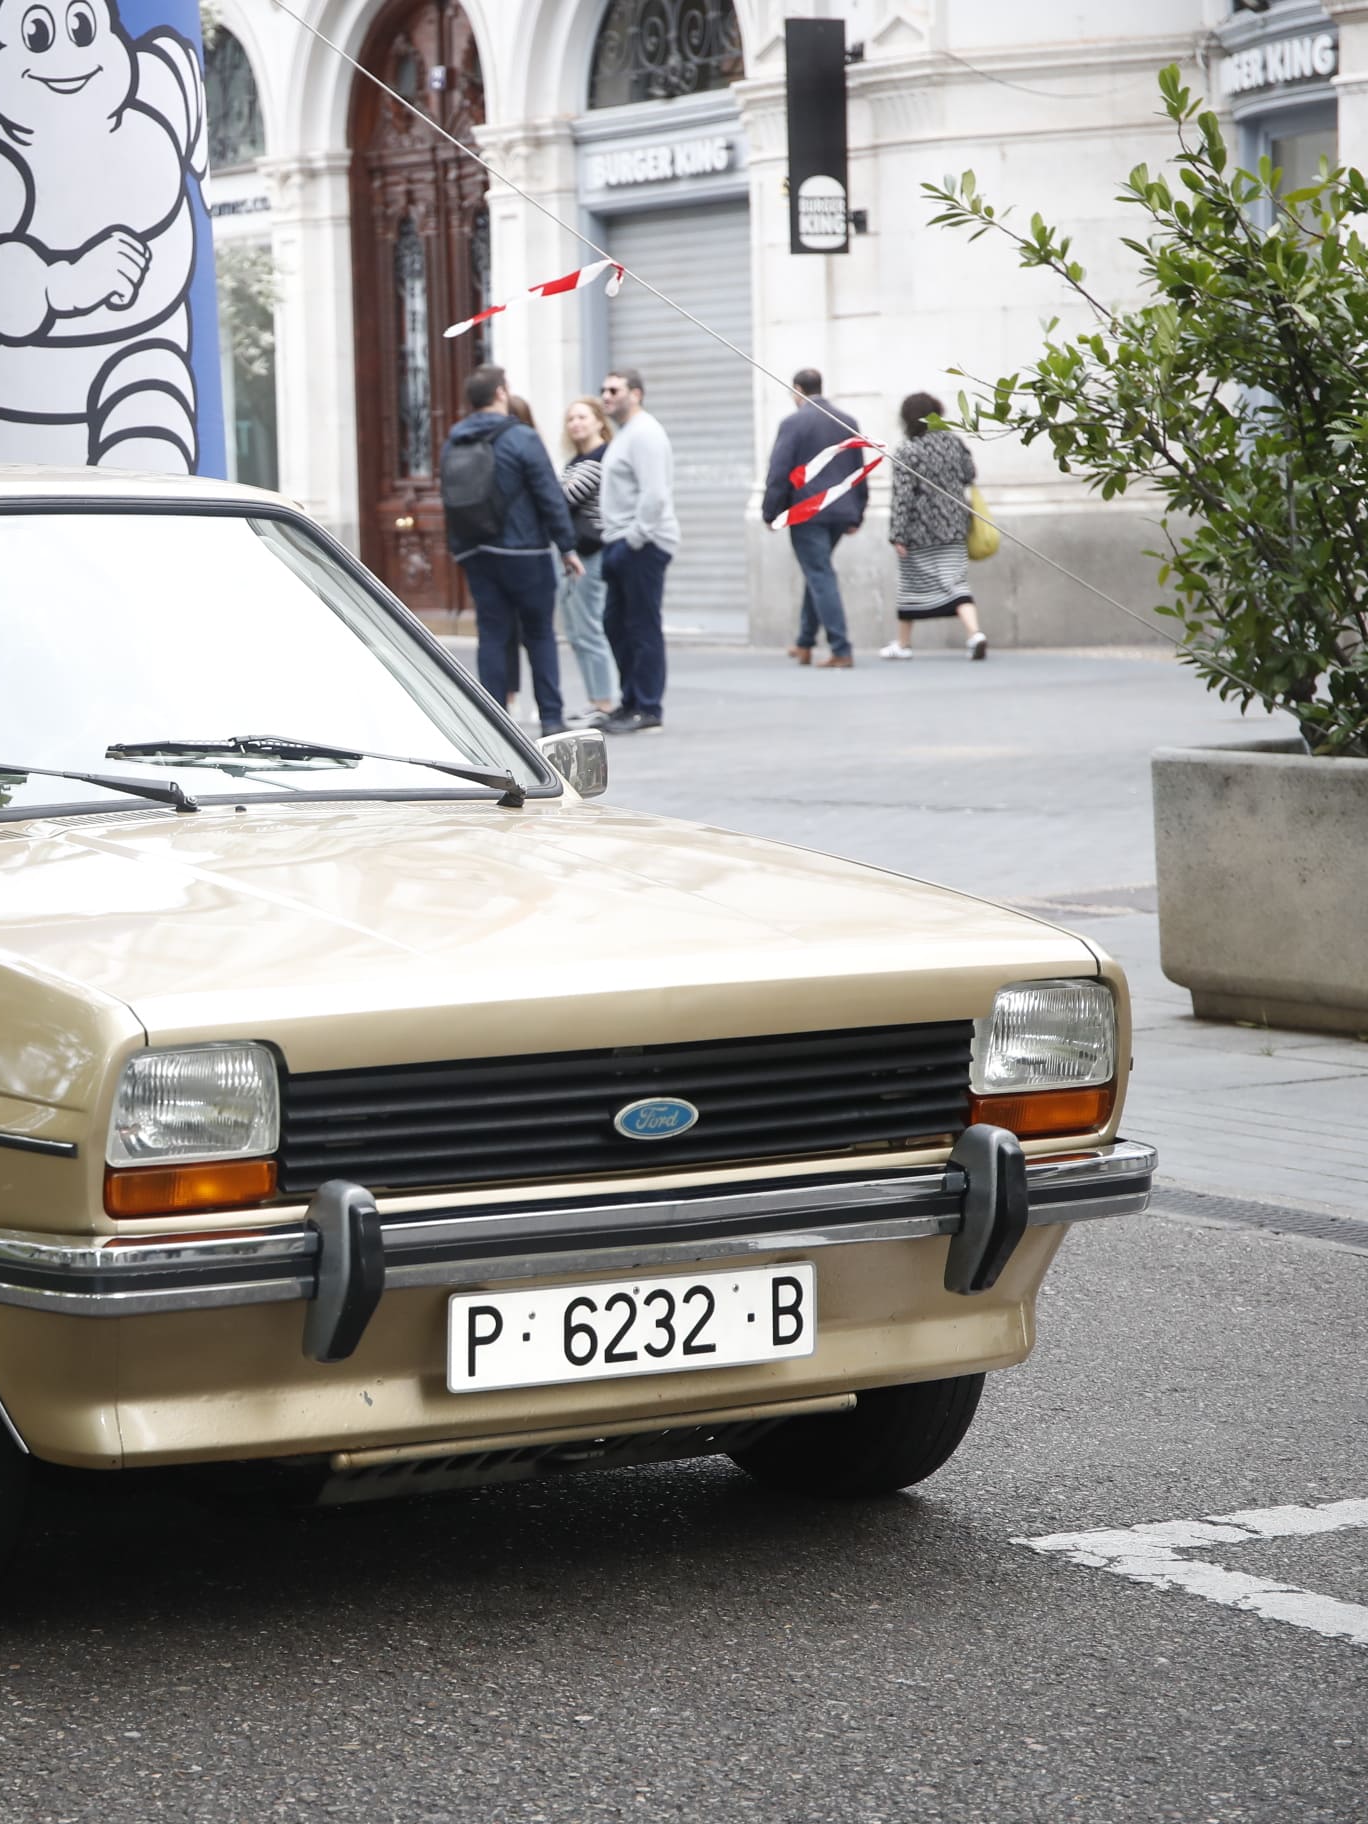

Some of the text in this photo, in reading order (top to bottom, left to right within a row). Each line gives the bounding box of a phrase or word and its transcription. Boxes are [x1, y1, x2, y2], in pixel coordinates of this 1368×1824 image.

[1266, 34, 1336, 84] KING
[590, 136, 729, 189] BURGER KING
[799, 197, 846, 213] BURGER
[799, 213, 846, 234] KING
[635, 1106, 680, 1130] Ford
[563, 1285, 717, 1367] 6232
